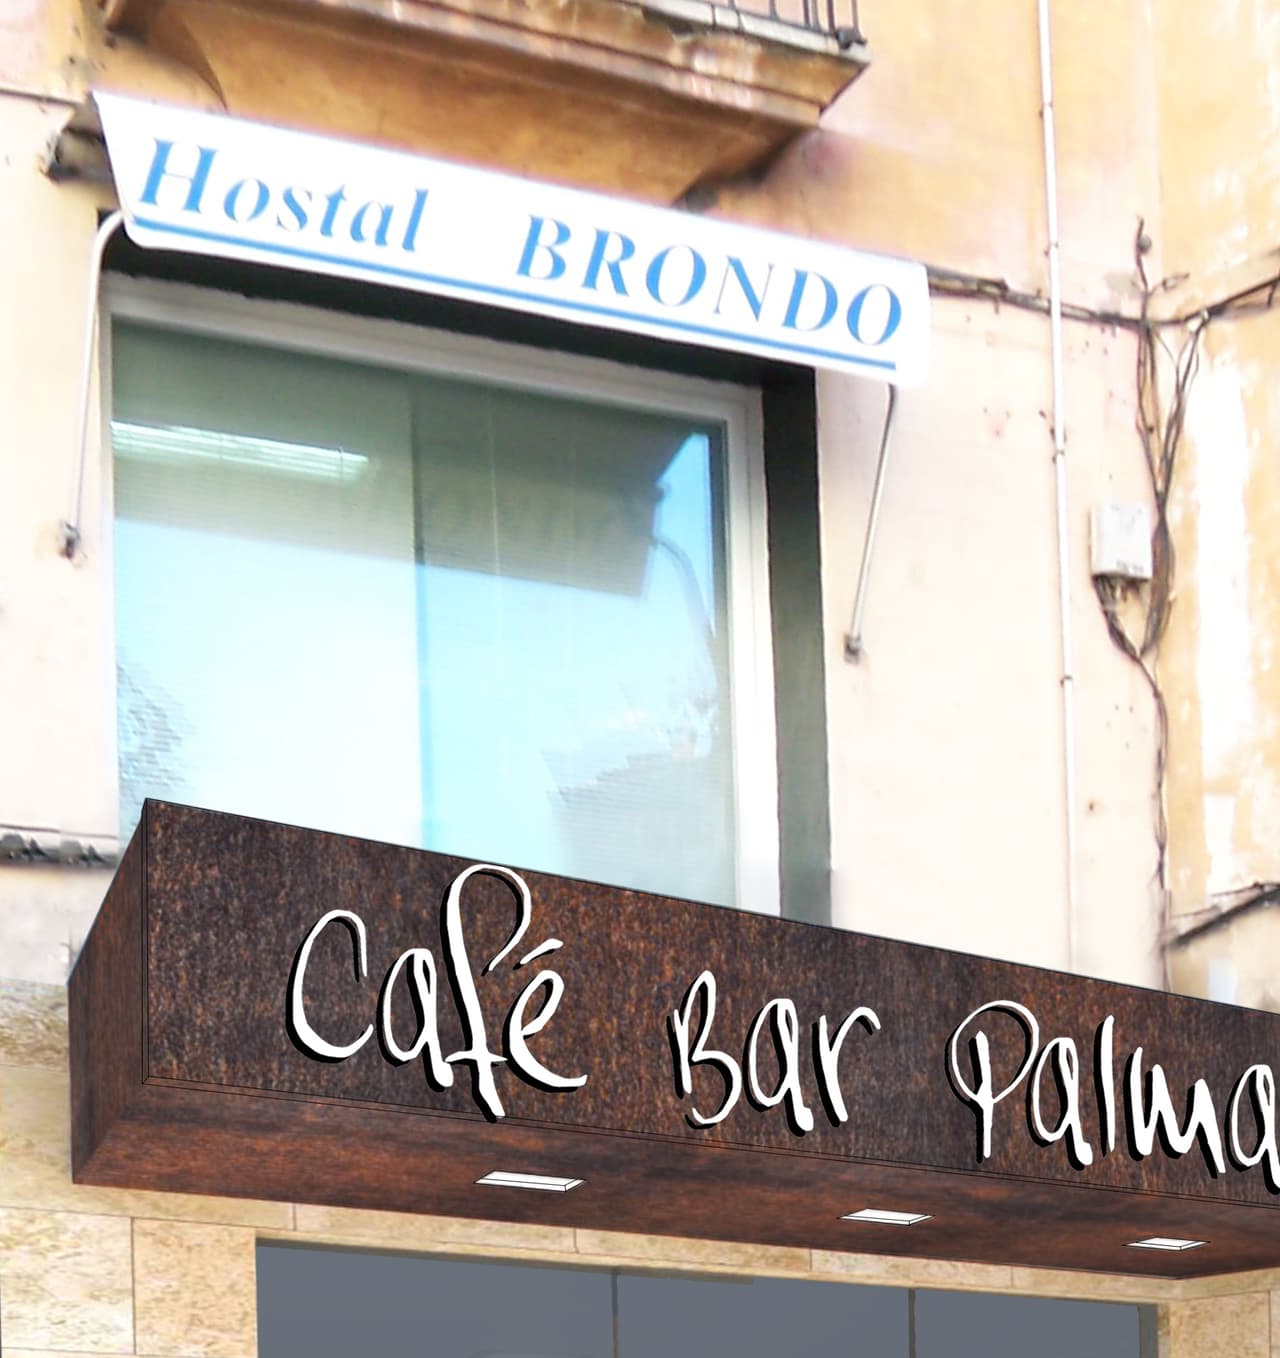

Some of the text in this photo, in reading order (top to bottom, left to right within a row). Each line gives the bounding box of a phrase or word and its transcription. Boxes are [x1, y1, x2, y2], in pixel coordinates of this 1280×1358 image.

[138, 138, 902, 347] Hostal BRONDO
[288, 862, 590, 1120] Café
[670, 968, 882, 1135] Bar
